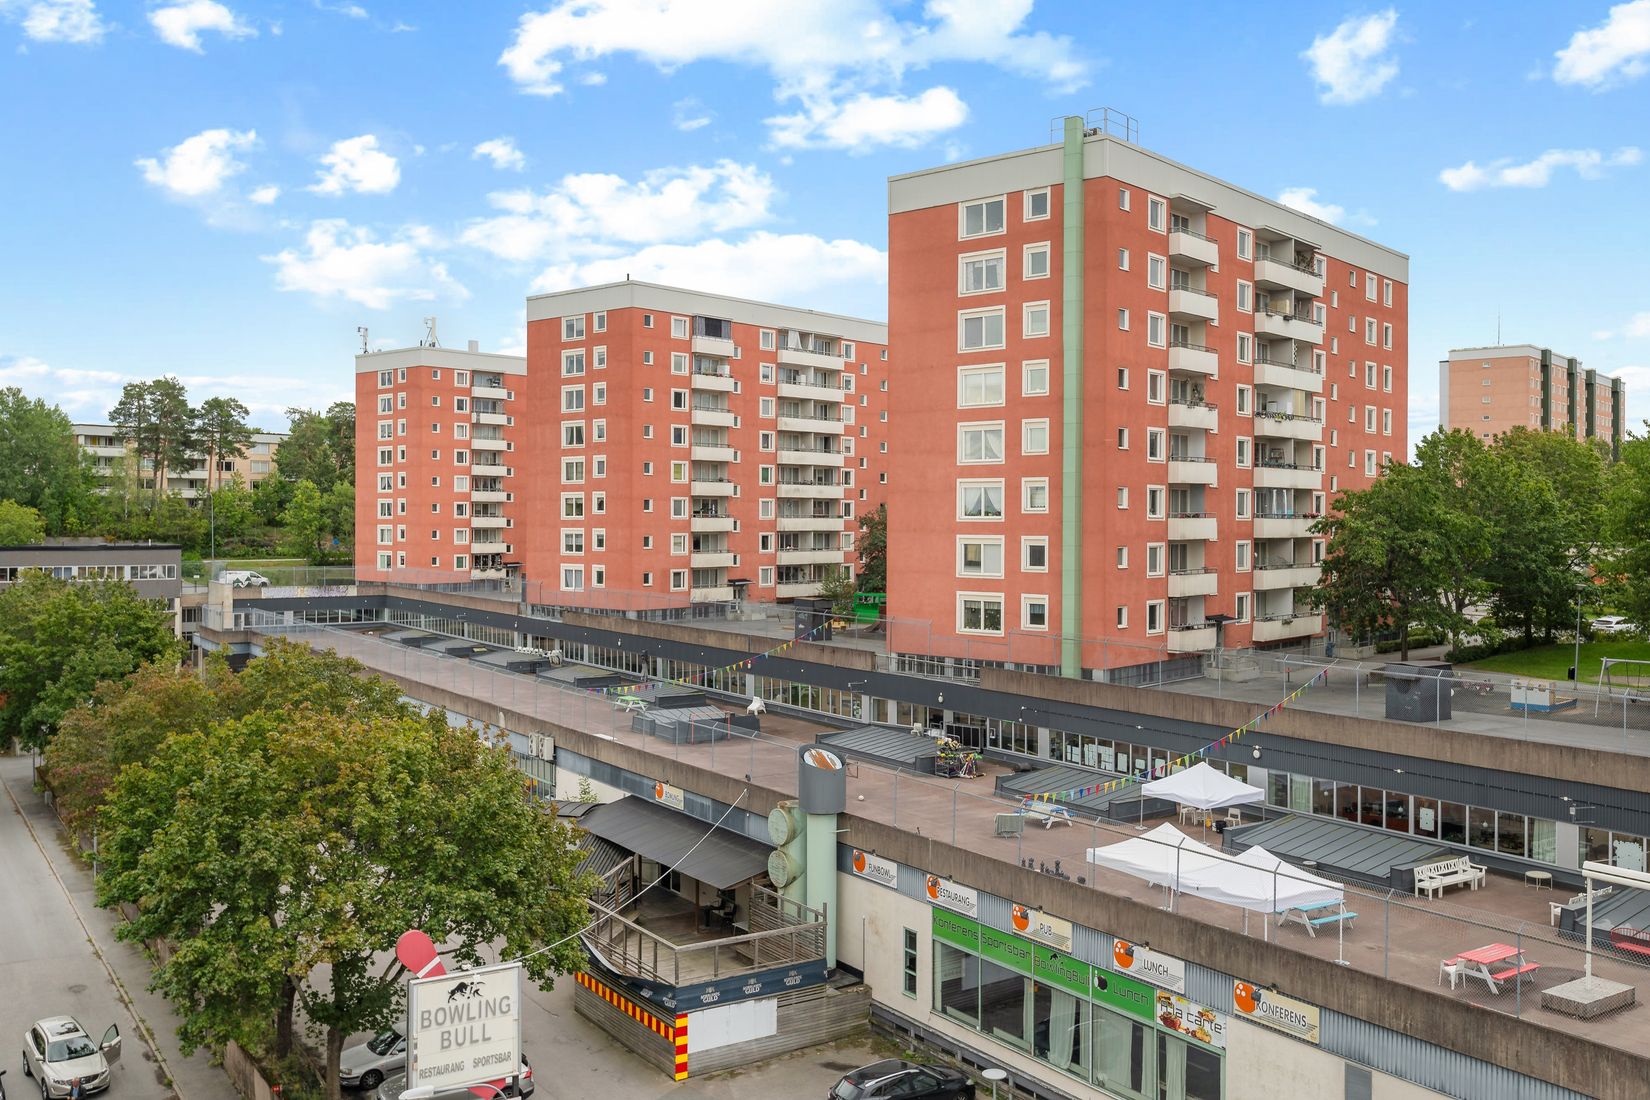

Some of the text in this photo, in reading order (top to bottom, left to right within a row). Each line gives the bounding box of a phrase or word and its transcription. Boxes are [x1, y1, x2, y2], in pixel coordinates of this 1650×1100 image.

[937, 886, 970, 906] RESTAURANG
[1039, 922, 1053, 936] PUB
[933, 916, 979, 941] Konferens
[981, 932, 1031, 959] Sportsbar
[1113, 982, 1149, 1006] Lunch
[1143, 959, 1169, 977] LUNCH
[420, 995, 511, 1030] BOWLING
[1186, 1012, 1223, 1035] carte
[1256, 1000, 1307, 1028] KONFERENS
[440, 1023, 492, 1051] BULL
[418, 1051, 512, 1080] RESTAURANG SPORTSBAR
